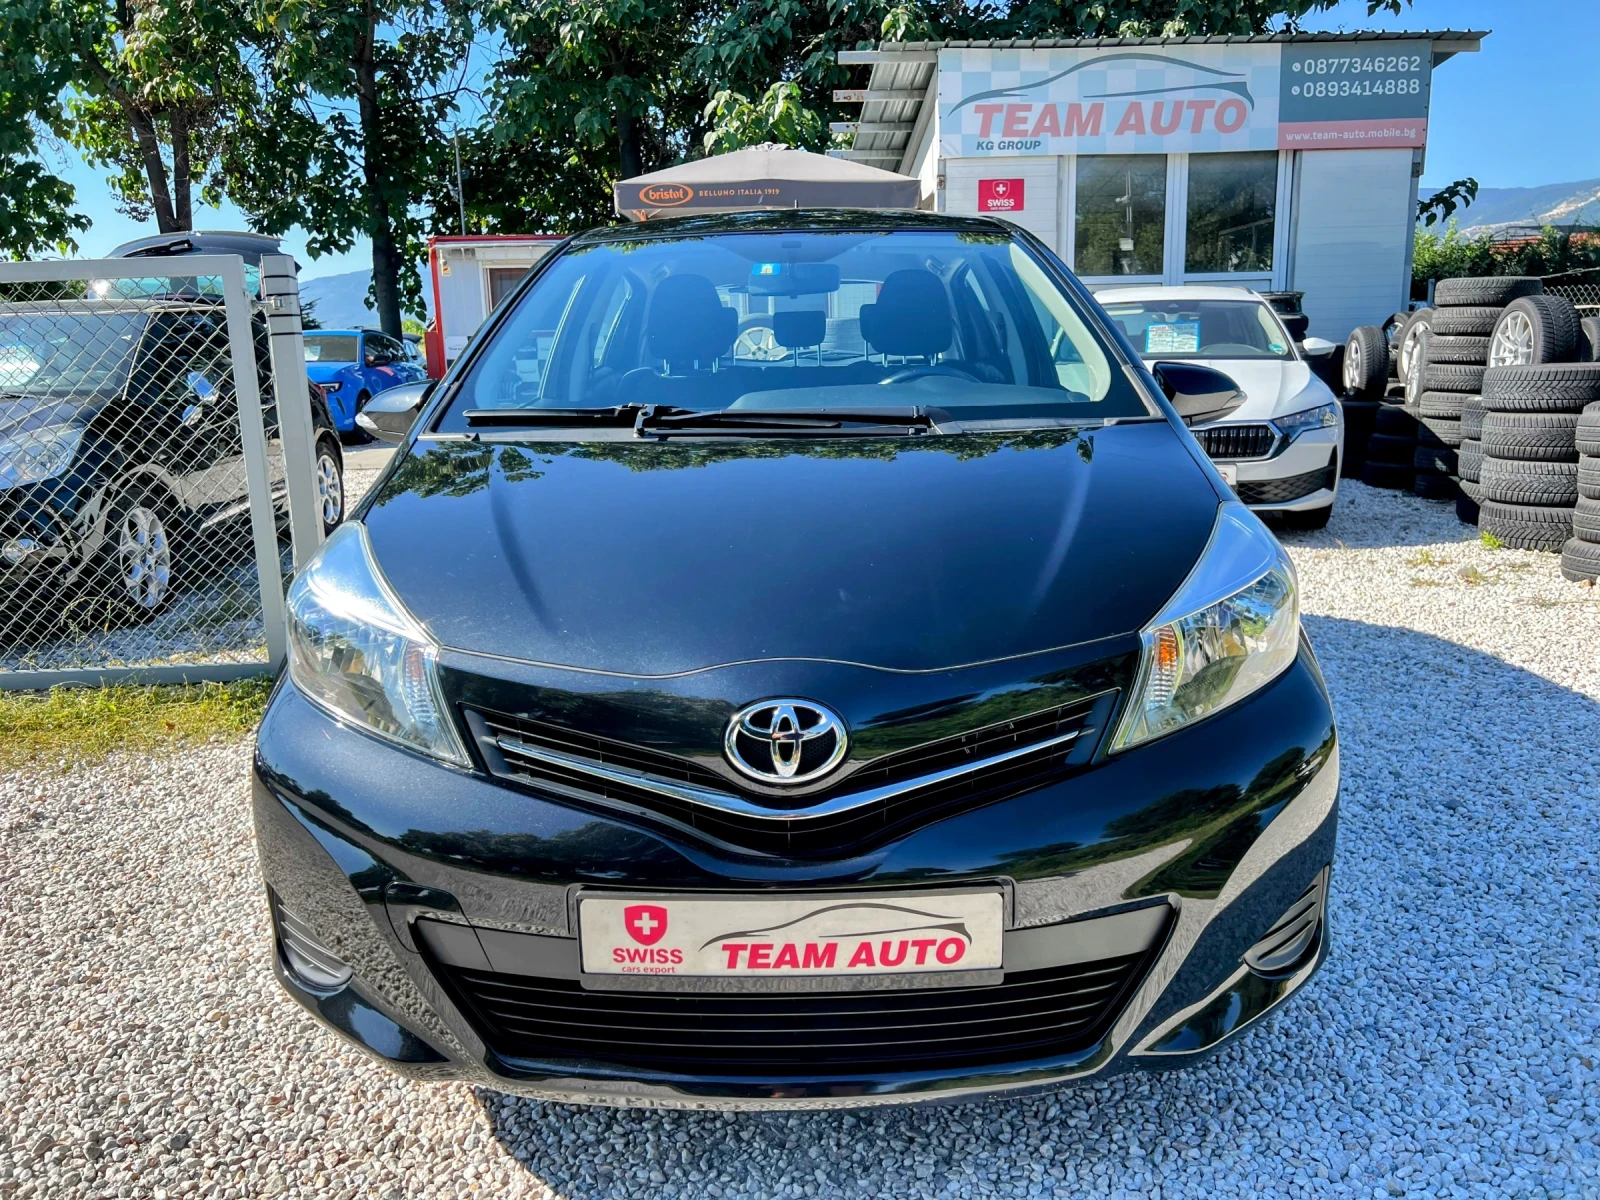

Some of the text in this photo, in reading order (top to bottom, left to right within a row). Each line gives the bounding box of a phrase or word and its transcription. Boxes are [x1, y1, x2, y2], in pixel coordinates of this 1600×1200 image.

[1304, 56, 1421, 75] 0877346262
[1303, 79, 1420, 98] 0893414888
[974, 98, 1248, 139] TEAM AUTO
[1286, 127, 1416, 141] www.team-auto.mobile.bg
[976, 140, 1042, 151] KG GROUP
[649, 188, 685, 200] bristot
[699, 189, 735, 197] BELLUNO
[737, 188, 763, 196] ITALIA
[987, 198, 1015, 207] SWISS
[612, 947, 684, 965] SWISS
[721, 936, 967, 970] TEAM AUTO
[643, 966, 676, 976] export
